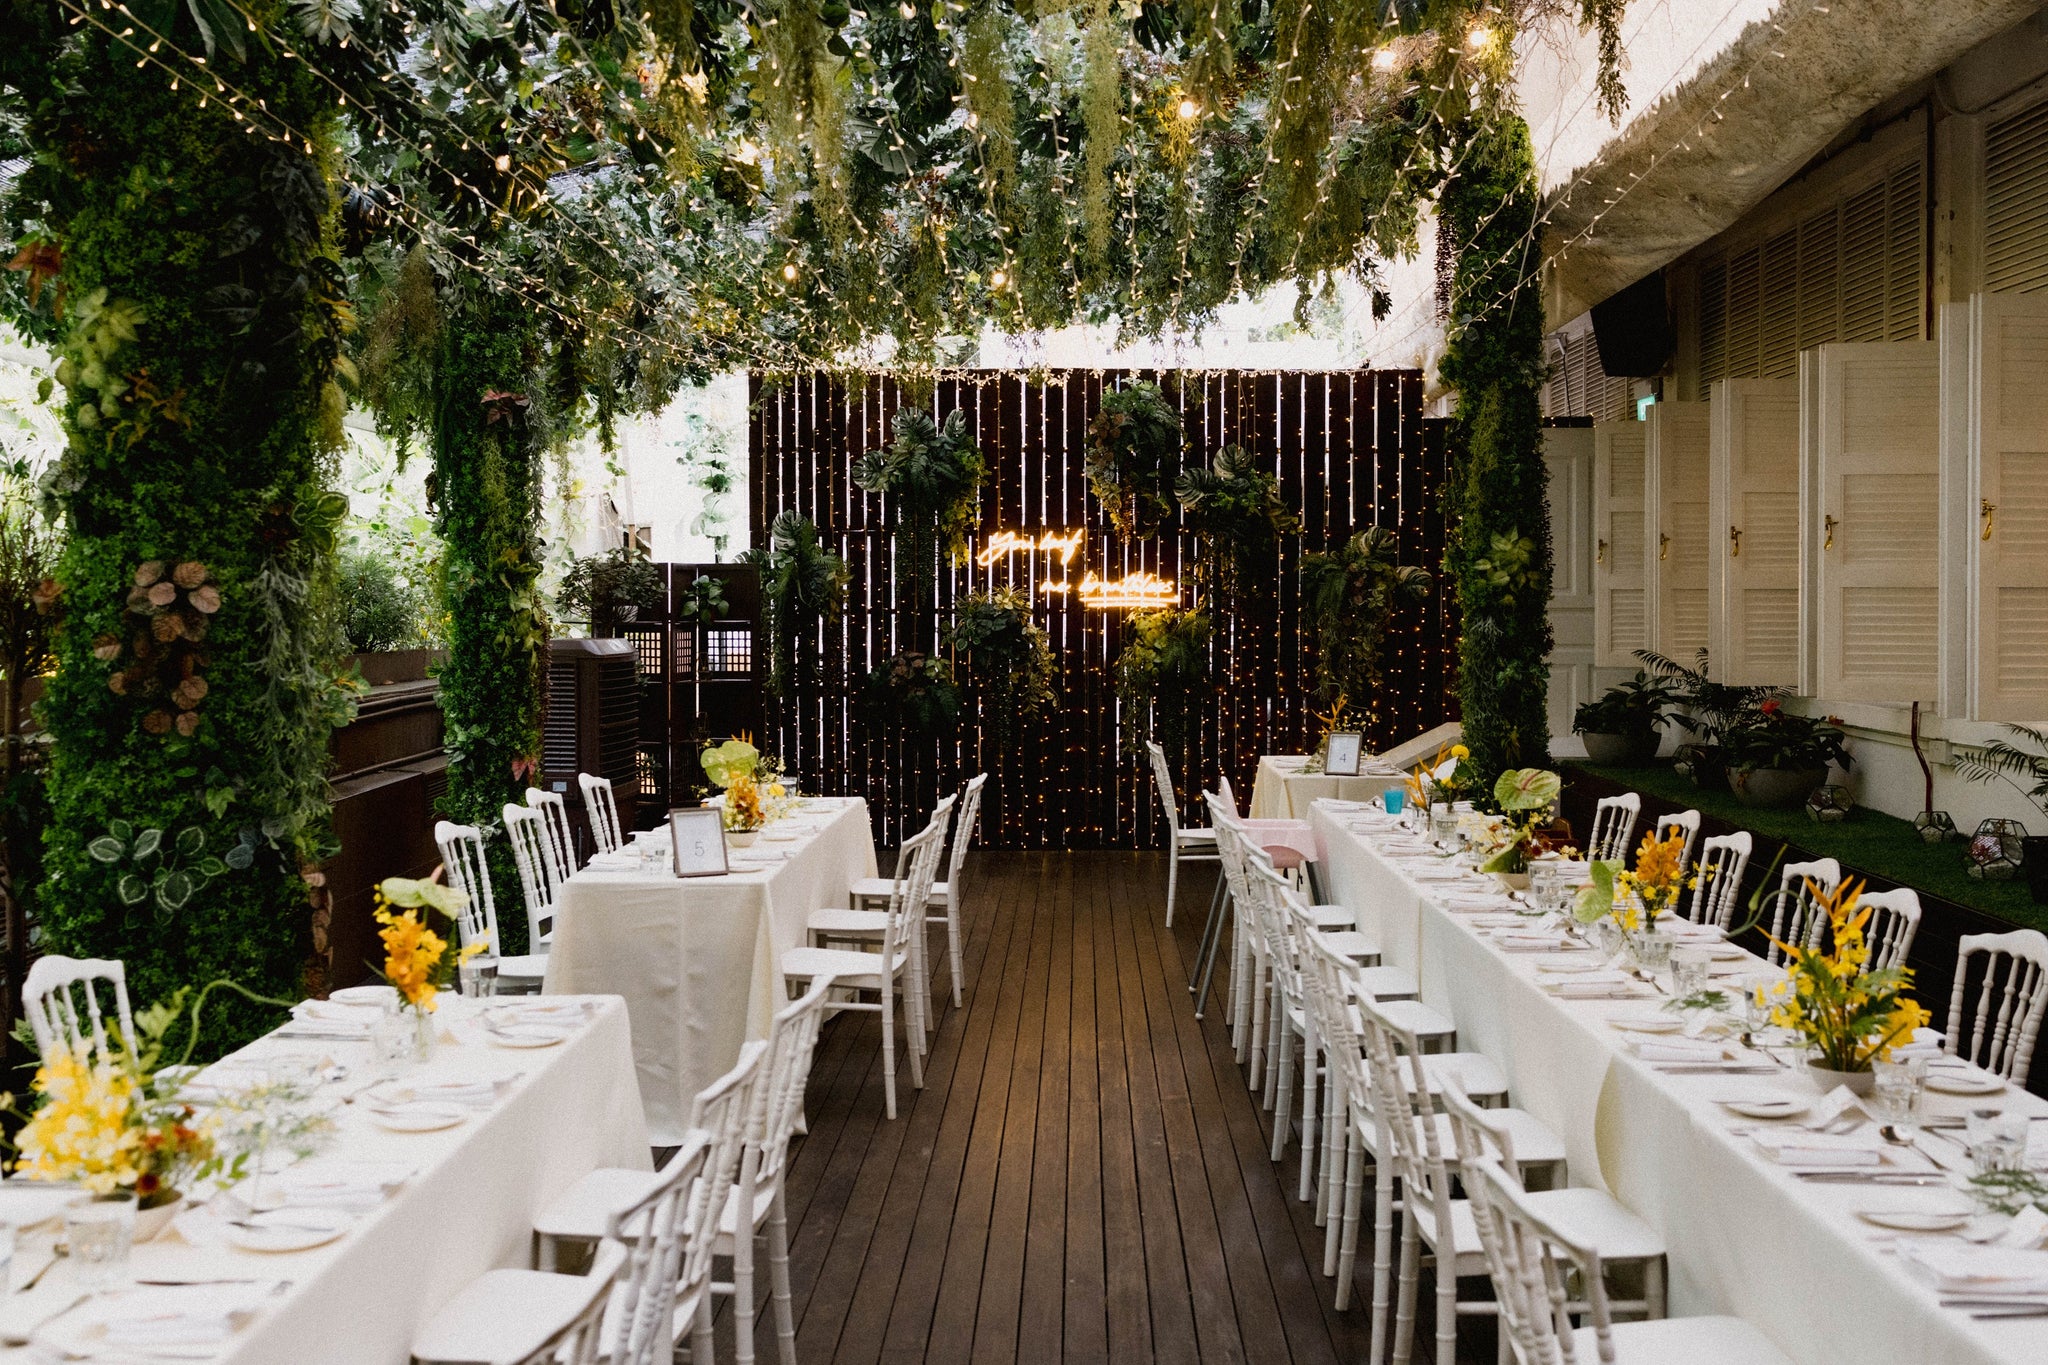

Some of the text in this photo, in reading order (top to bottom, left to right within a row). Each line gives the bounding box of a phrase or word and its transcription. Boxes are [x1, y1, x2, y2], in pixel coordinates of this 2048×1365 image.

[977, 531, 1036, 566] You
[1039, 570, 1174, 593] me breathless
[1339, 753, 1346, 763] 4
[694, 841, 705, 857] 5
